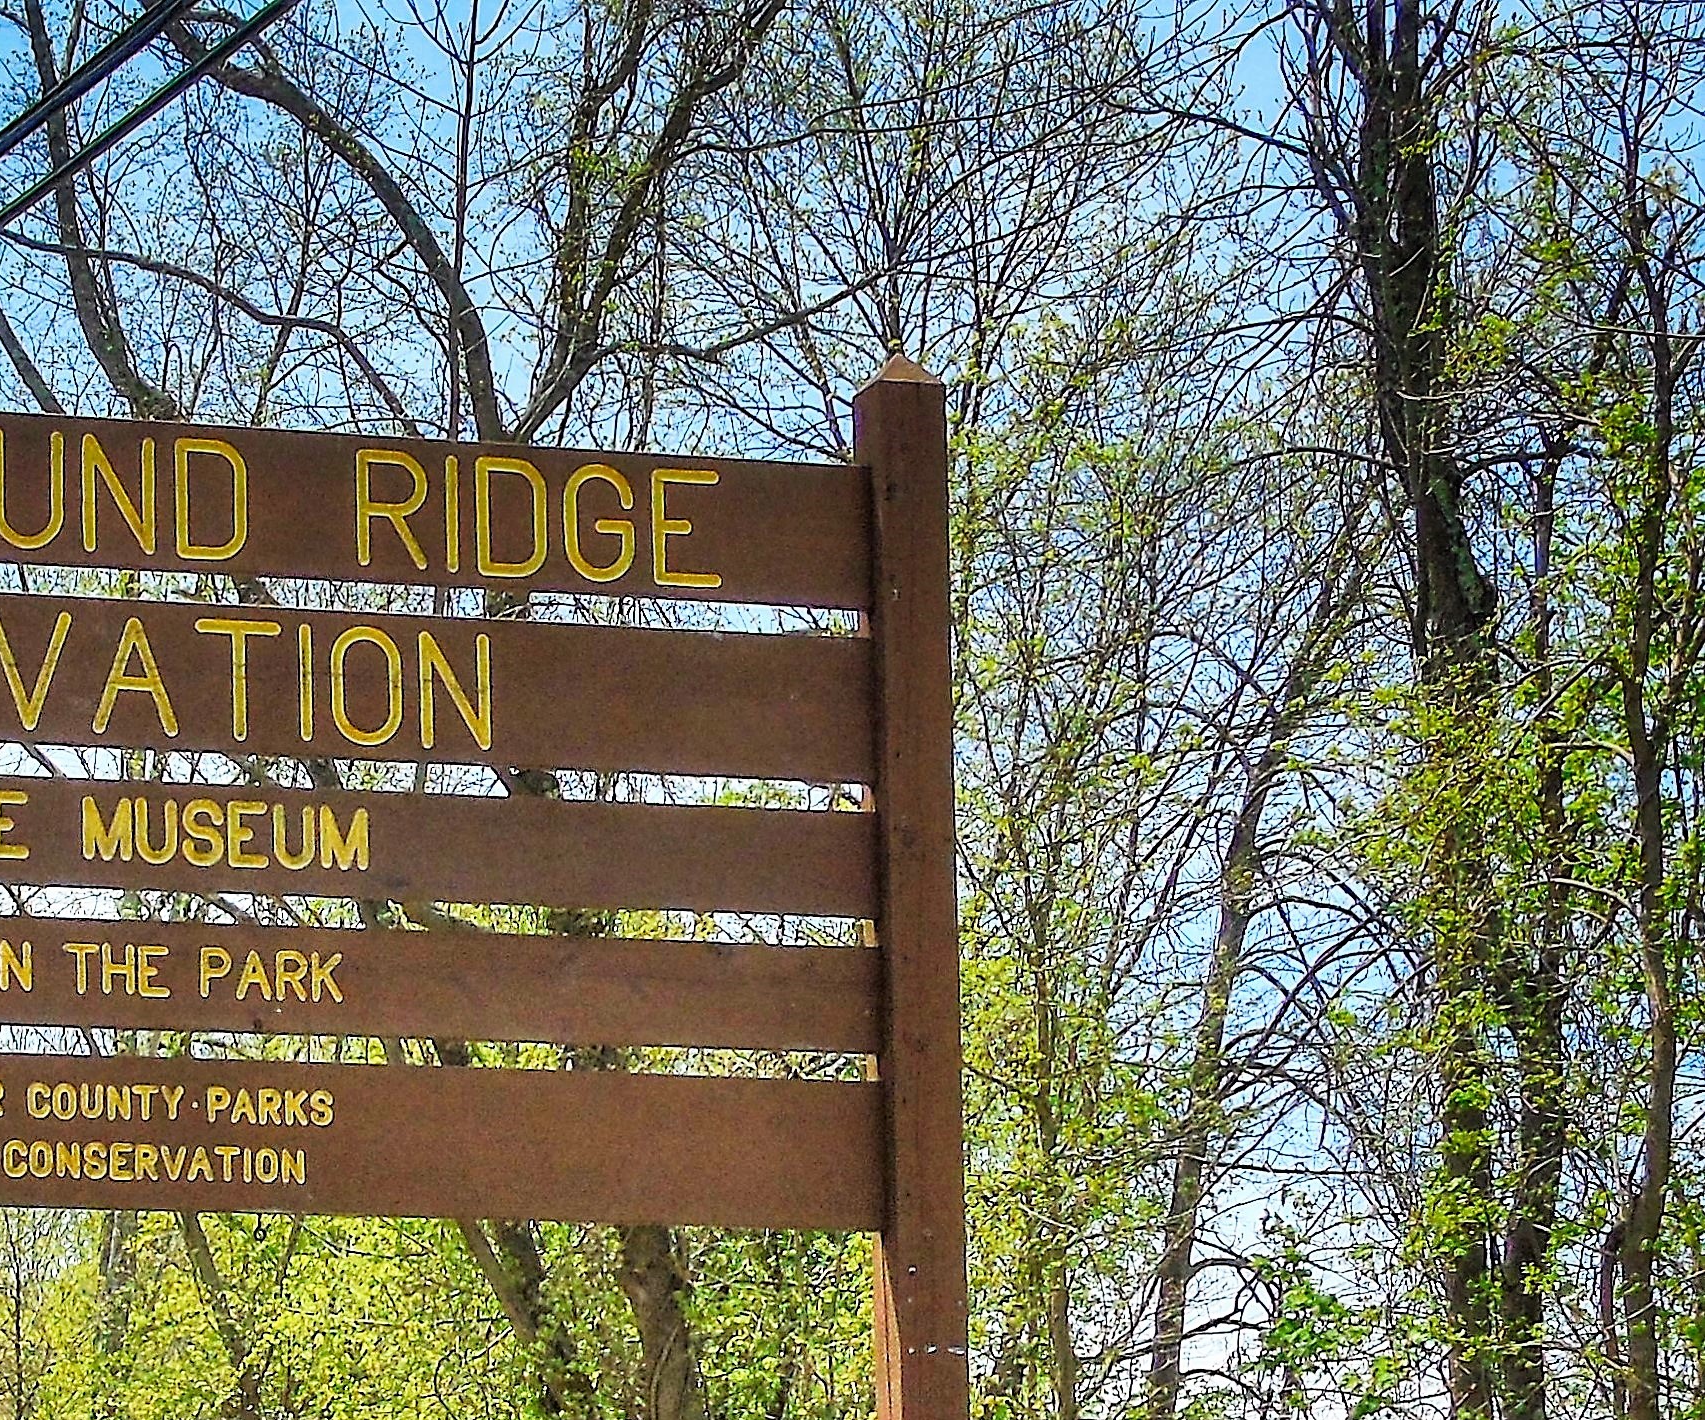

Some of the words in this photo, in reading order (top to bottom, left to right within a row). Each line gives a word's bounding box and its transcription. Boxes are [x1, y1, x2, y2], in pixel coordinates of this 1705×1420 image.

[355, 448, 724, 588] RIDGE
[82, 794, 370, 872] MUSEUM
[62, 941, 171, 998] THE
[198, 945, 346, 1004] PARK
[25, 1082, 184, 1123] COUNTY
[206, 1087, 335, 1127] PARKS
